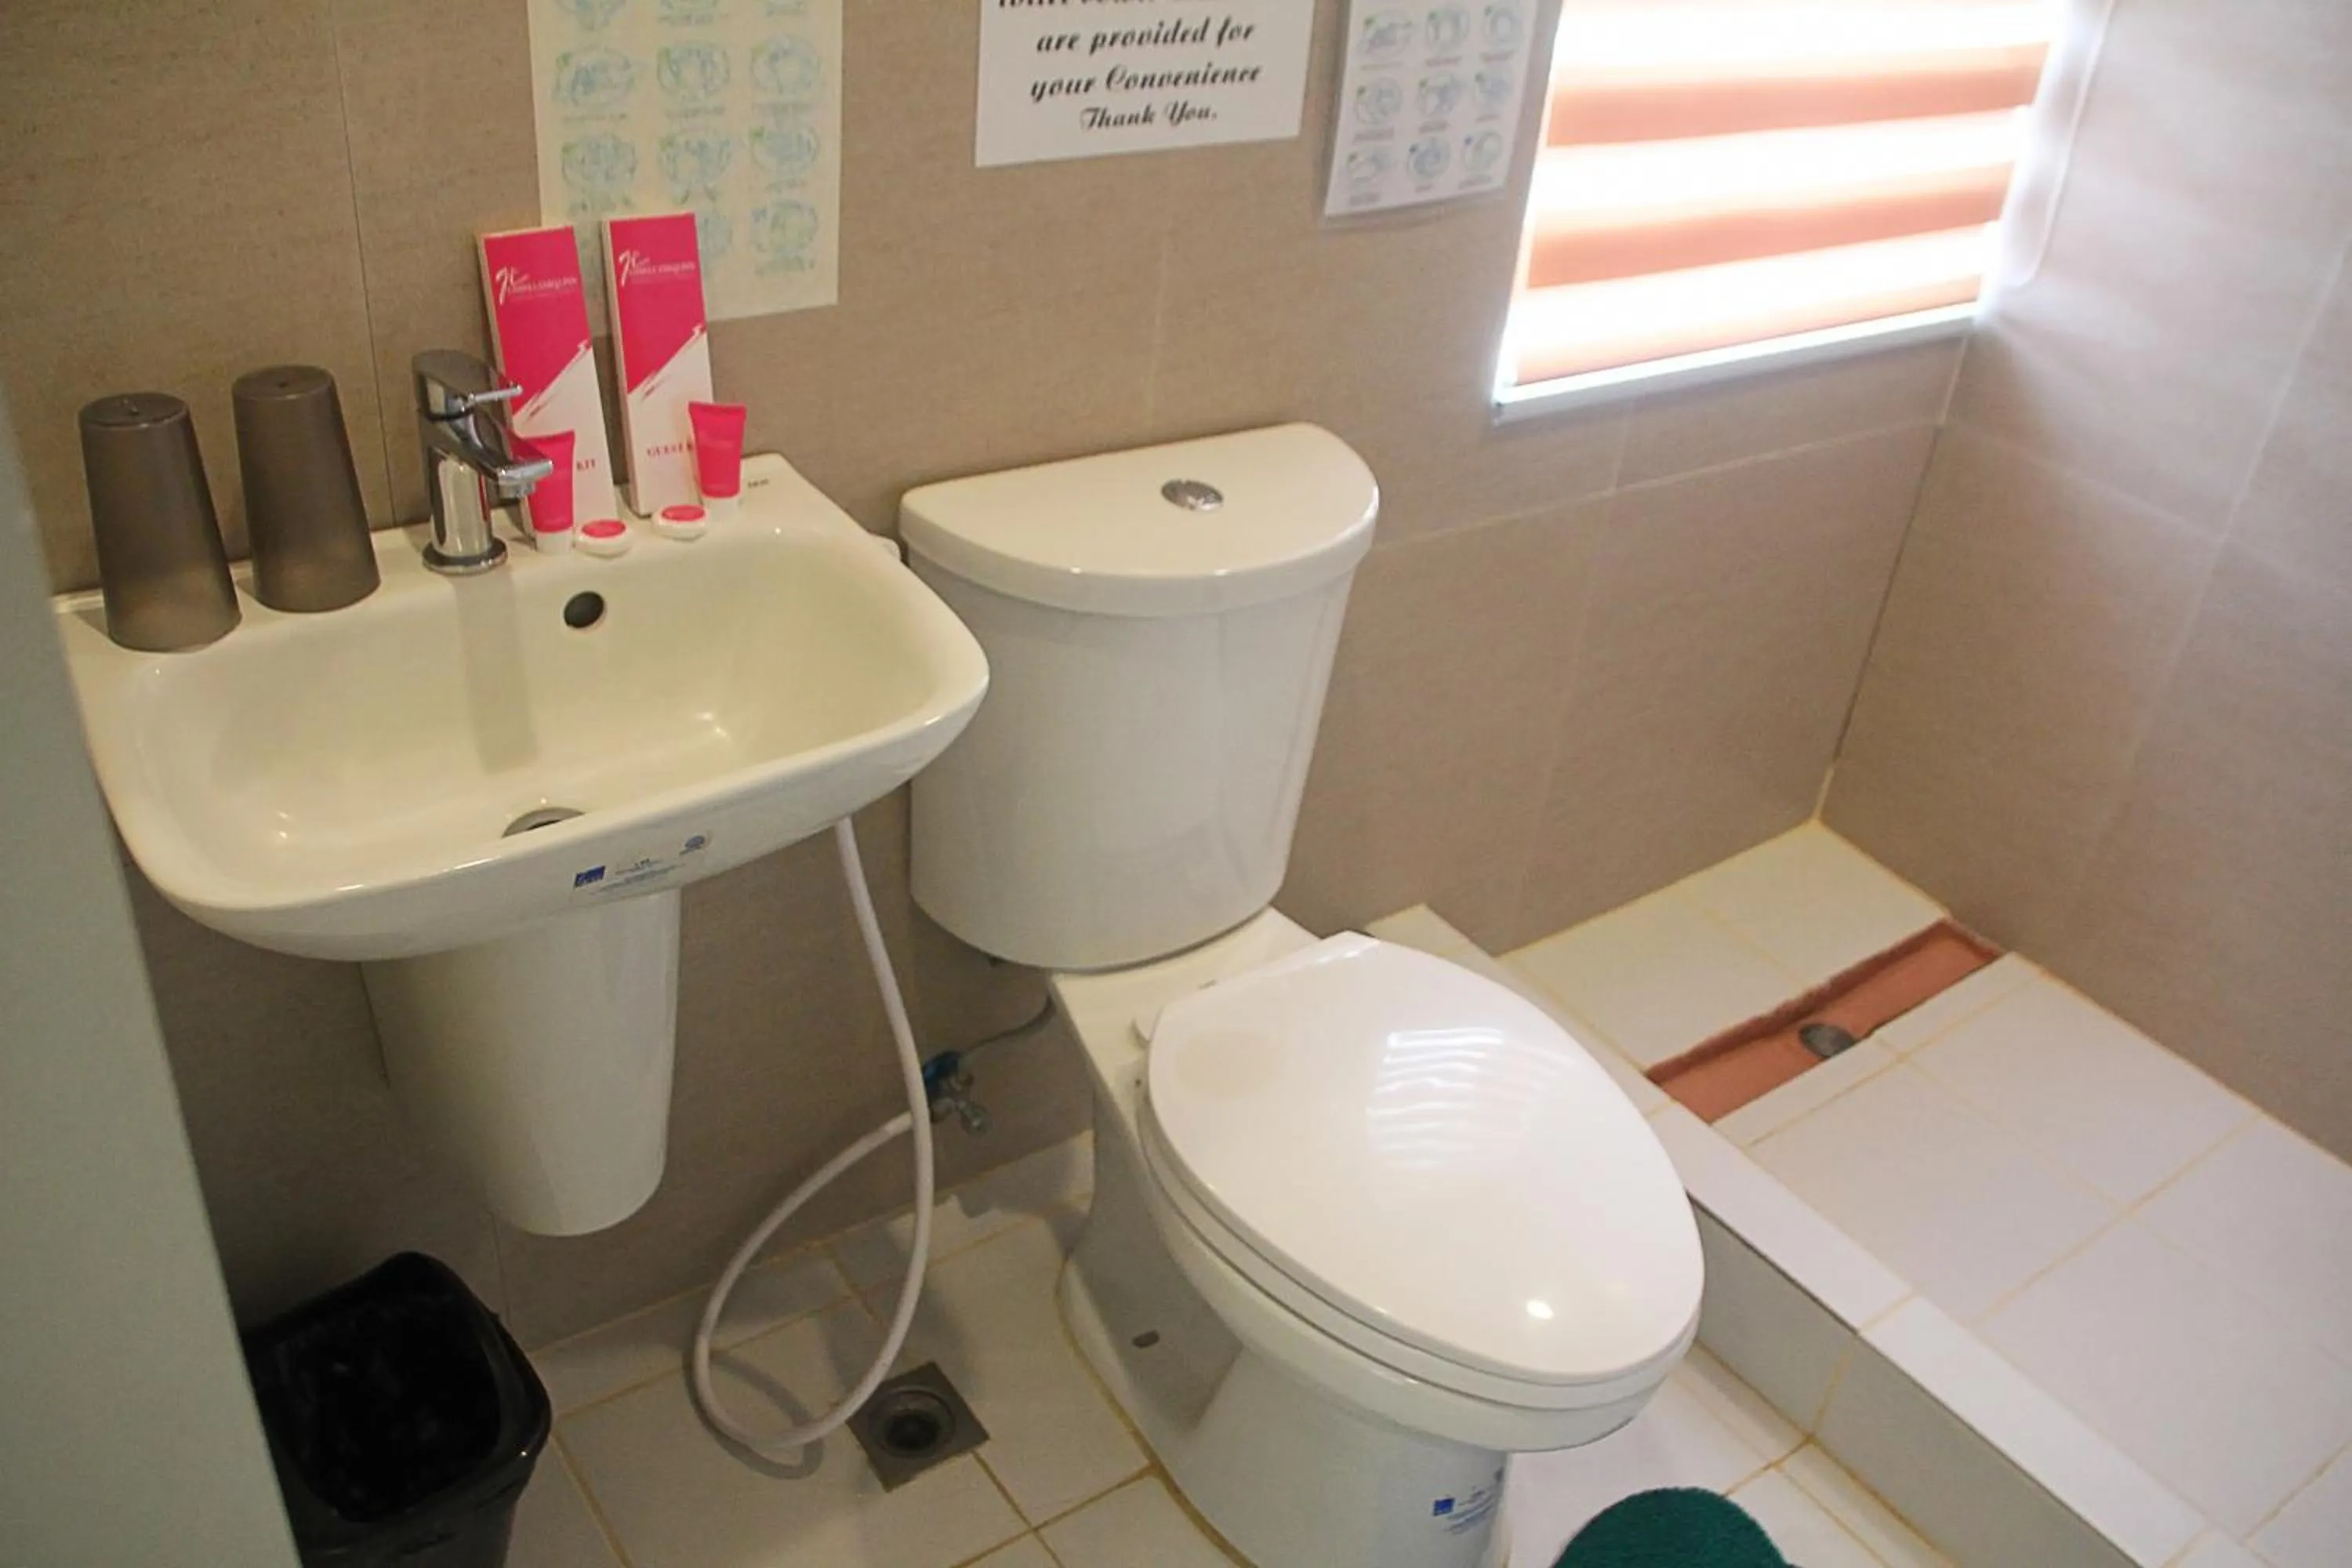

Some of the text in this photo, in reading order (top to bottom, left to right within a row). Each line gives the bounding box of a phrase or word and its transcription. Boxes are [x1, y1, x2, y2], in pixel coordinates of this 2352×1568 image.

[1036, 16, 1254, 56] are provided for
[1030, 61, 1261, 102] your Convenience
[1080, 100, 1218, 129] Thank You.
